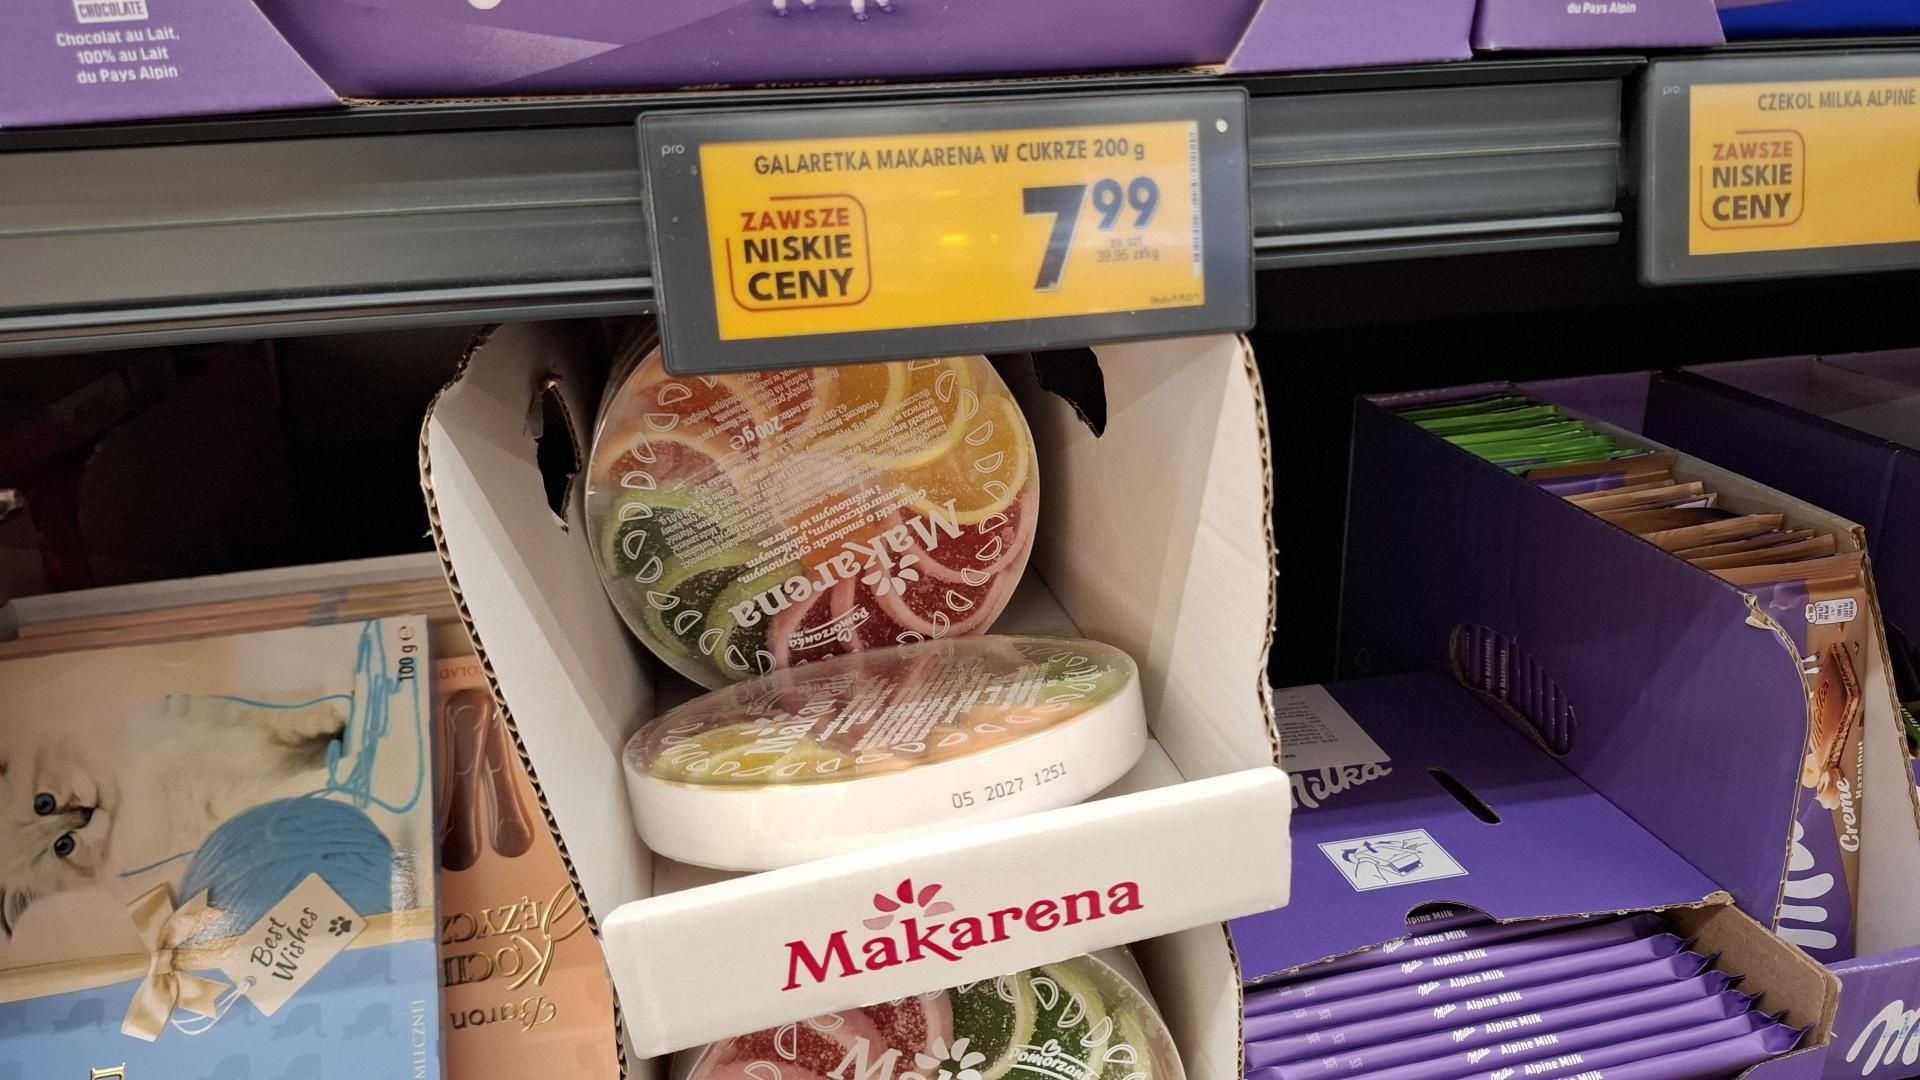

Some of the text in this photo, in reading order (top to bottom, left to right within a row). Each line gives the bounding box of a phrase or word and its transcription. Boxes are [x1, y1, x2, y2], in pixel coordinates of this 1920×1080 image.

[78, 1, 145, 19] CHOCOLATE
[1567, 1, 1637, 15] du Pays Alpin
[56, 30, 122, 47] Chocolat
[126, 30, 144, 42] au
[76, 47, 169, 65] 100% au Lait
[77, 65, 178, 84] du Pays Alpin
[1662, 84, 1681, 96] pro
[1758, 87, 1917, 112] CZEKOL MILKA ALPINE
[662, 143, 685, 157] pro
[754, 138, 1145, 175] GALARETKA MAKARENA W CUKRZE 200 g
[1713, 140, 1793, 162] ZAWSZE
[1713, 163, 1793, 188] NISKIE
[740, 207, 850, 232] ZAWSZE
[1712, 192, 1792, 221] CENY
[743, 234, 853, 264] NISKIE
[748, 267, 855, 301] CENY
[781, 371, 808, 390] nadruk
[783, 380, 809, 400] spożyć
[679, 406, 710, 428] miejscu.
[778, 404, 802, 422] netto:
[840, 398, 878, 422] Producent:
[906, 405, 939, 427] orzeszki
[753, 414, 783, 440] 200
[809, 484, 876, 526] wiśniowym
[692, 511, 723, 532] gluten.
[743, 482, 908, 571] pomarańczowym, jabłkowym
[797, 518, 811, 530] w
[663, 525, 695, 547] Wartość
[735, 487, 928, 587] Galaretki o smakach: cytrynowym,
[757, 524, 800, 551] cukrze.
[728, 498, 966, 629] Makarena
[397, 644, 418, 682] 100 g
[1855, 740, 1864, 800] Hazelnut
[951, 762, 1067, 809] 05 2027 1251
[1837, 776, 1860, 852] Creme
[1432, 909, 1455, 921] Milk
[250, 916, 287, 967] Best
[272, 907, 318, 981] Wishes
[781, 881, 1144, 992] Makarena
[1413, 932, 1445, 947] Alpine
[1446, 929, 1468, 942] Milk
[1401, 948, 1488, 975] Milka Alpine Milk
[1418, 968, 1505, 997] Milka Alpine Milk
[450, 997, 556, 1033] Baron
[1433, 991, 1523, 1020] Milka Alpine Milk
[1452, 1013, 1543, 1043] Milka Alpine Milk
[1467, 1034, 1559, 1064] Milka Alpine Milk
[1490, 1054, 1584, 1080] Milka Alpine Milk
